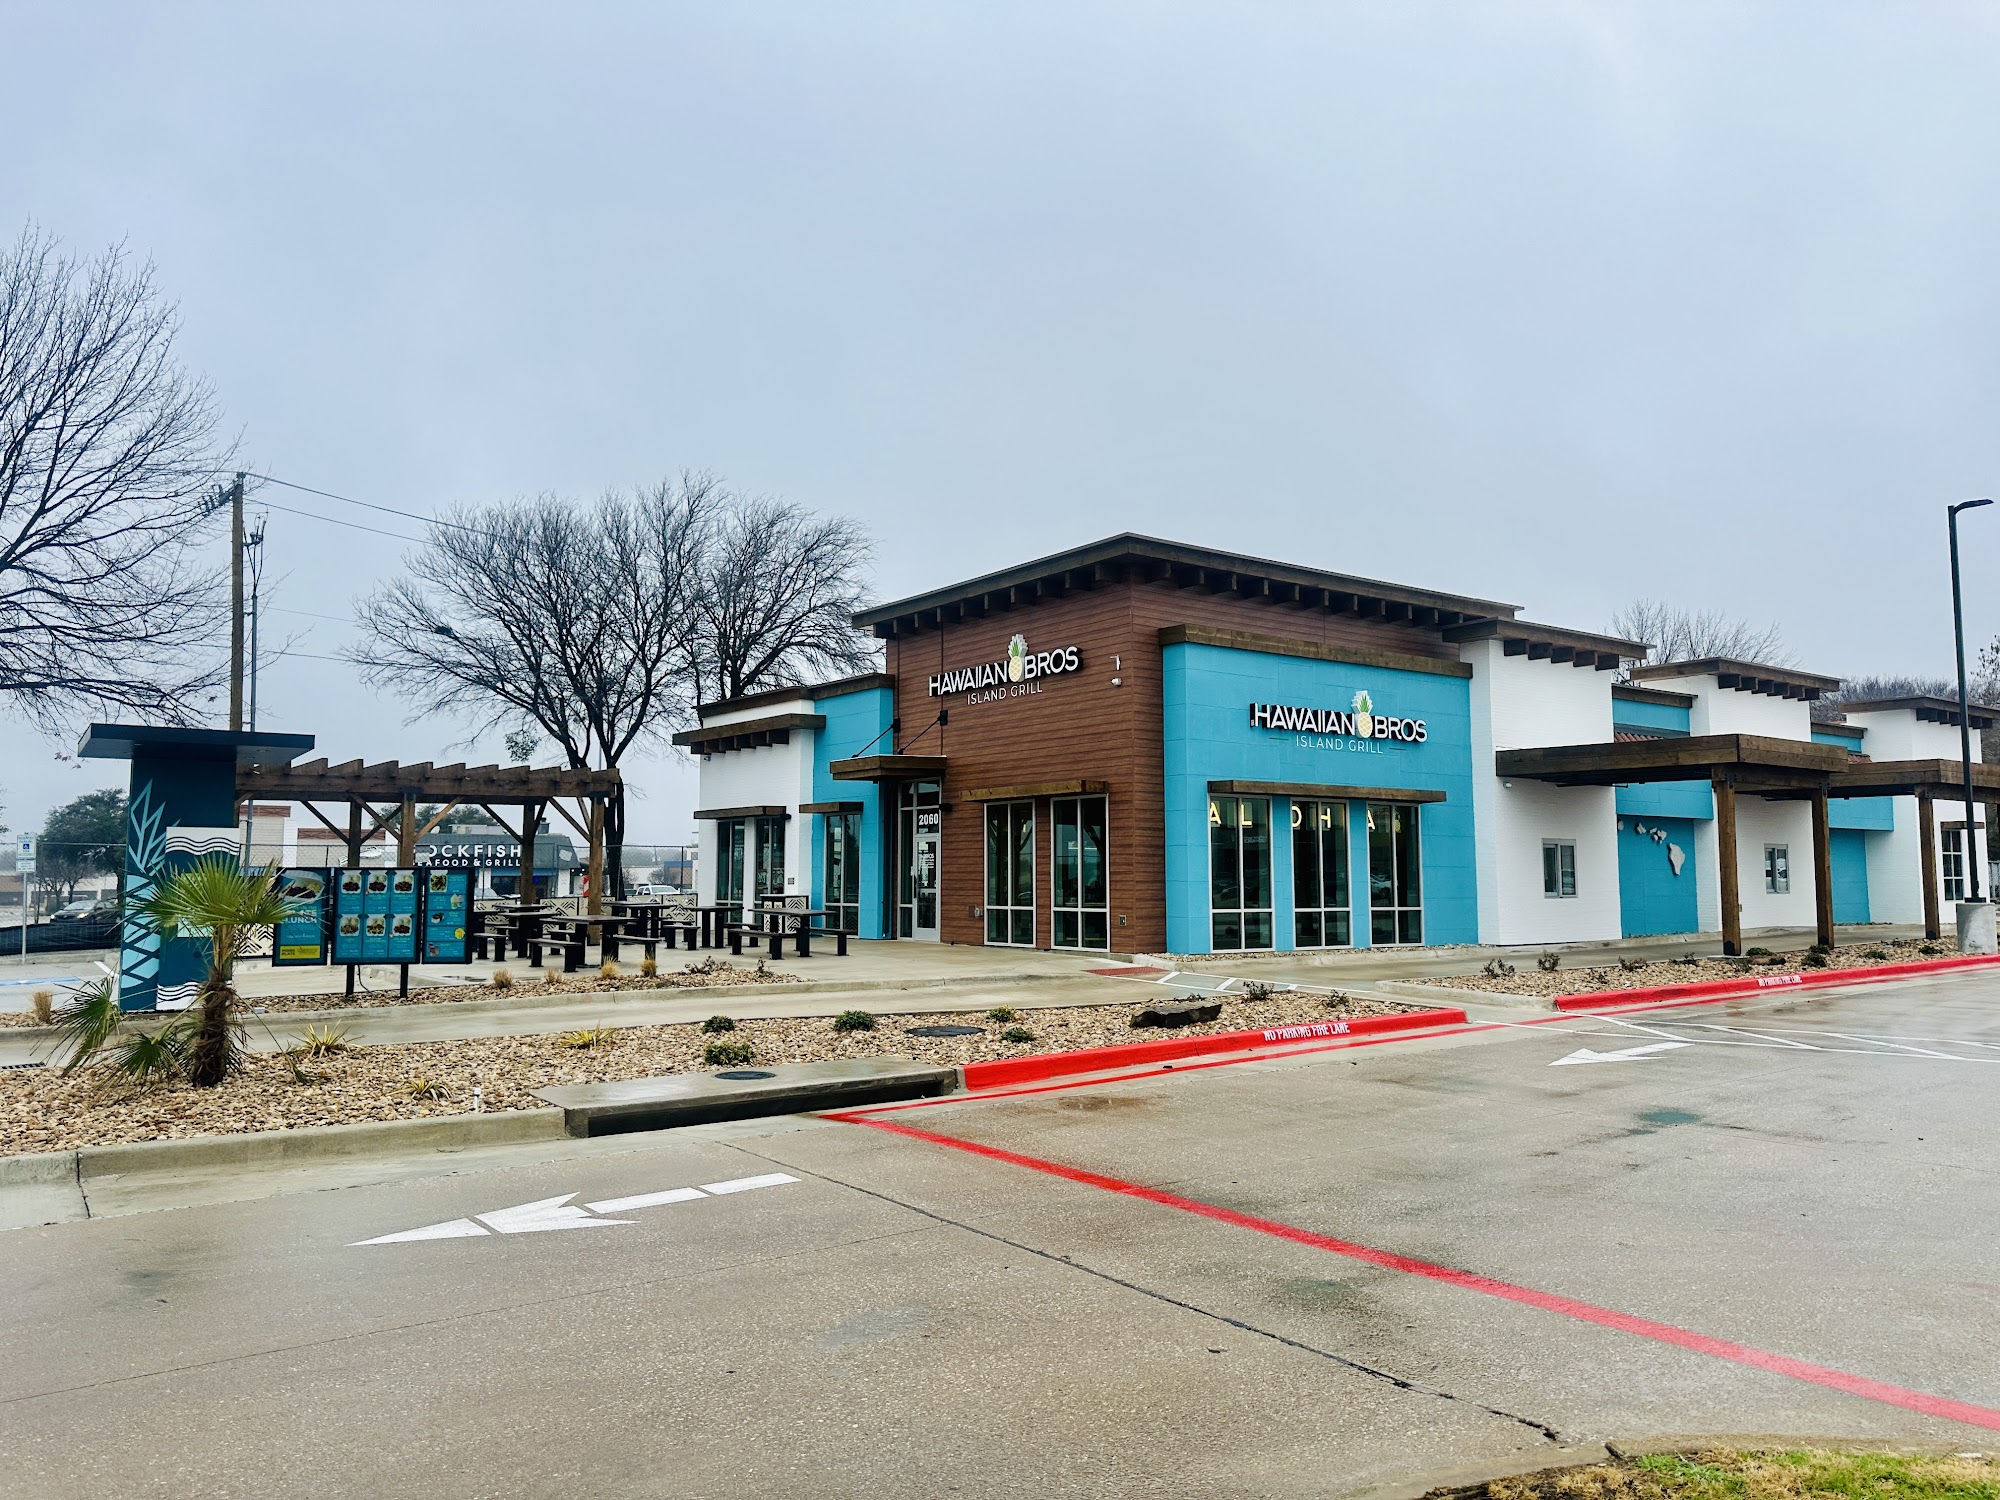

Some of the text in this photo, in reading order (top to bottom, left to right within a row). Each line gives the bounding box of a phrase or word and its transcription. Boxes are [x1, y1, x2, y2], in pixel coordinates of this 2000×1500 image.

[928, 646, 1080, 697] HAWAIIAN BROS
[967, 681, 1043, 705] ISLAND GRILL
[1253, 702, 1428, 743] HAWAIIAN BROS
[1295, 735, 1384, 754] ISLAND GRILL
[918, 813, 939, 826] 2060
[413, 845, 521, 858] OCKFISH
[413, 858, 521, 867] EAFOOD & GRILL
[1262, 1021, 1351, 1041] NO PARKING FIRE LANE
